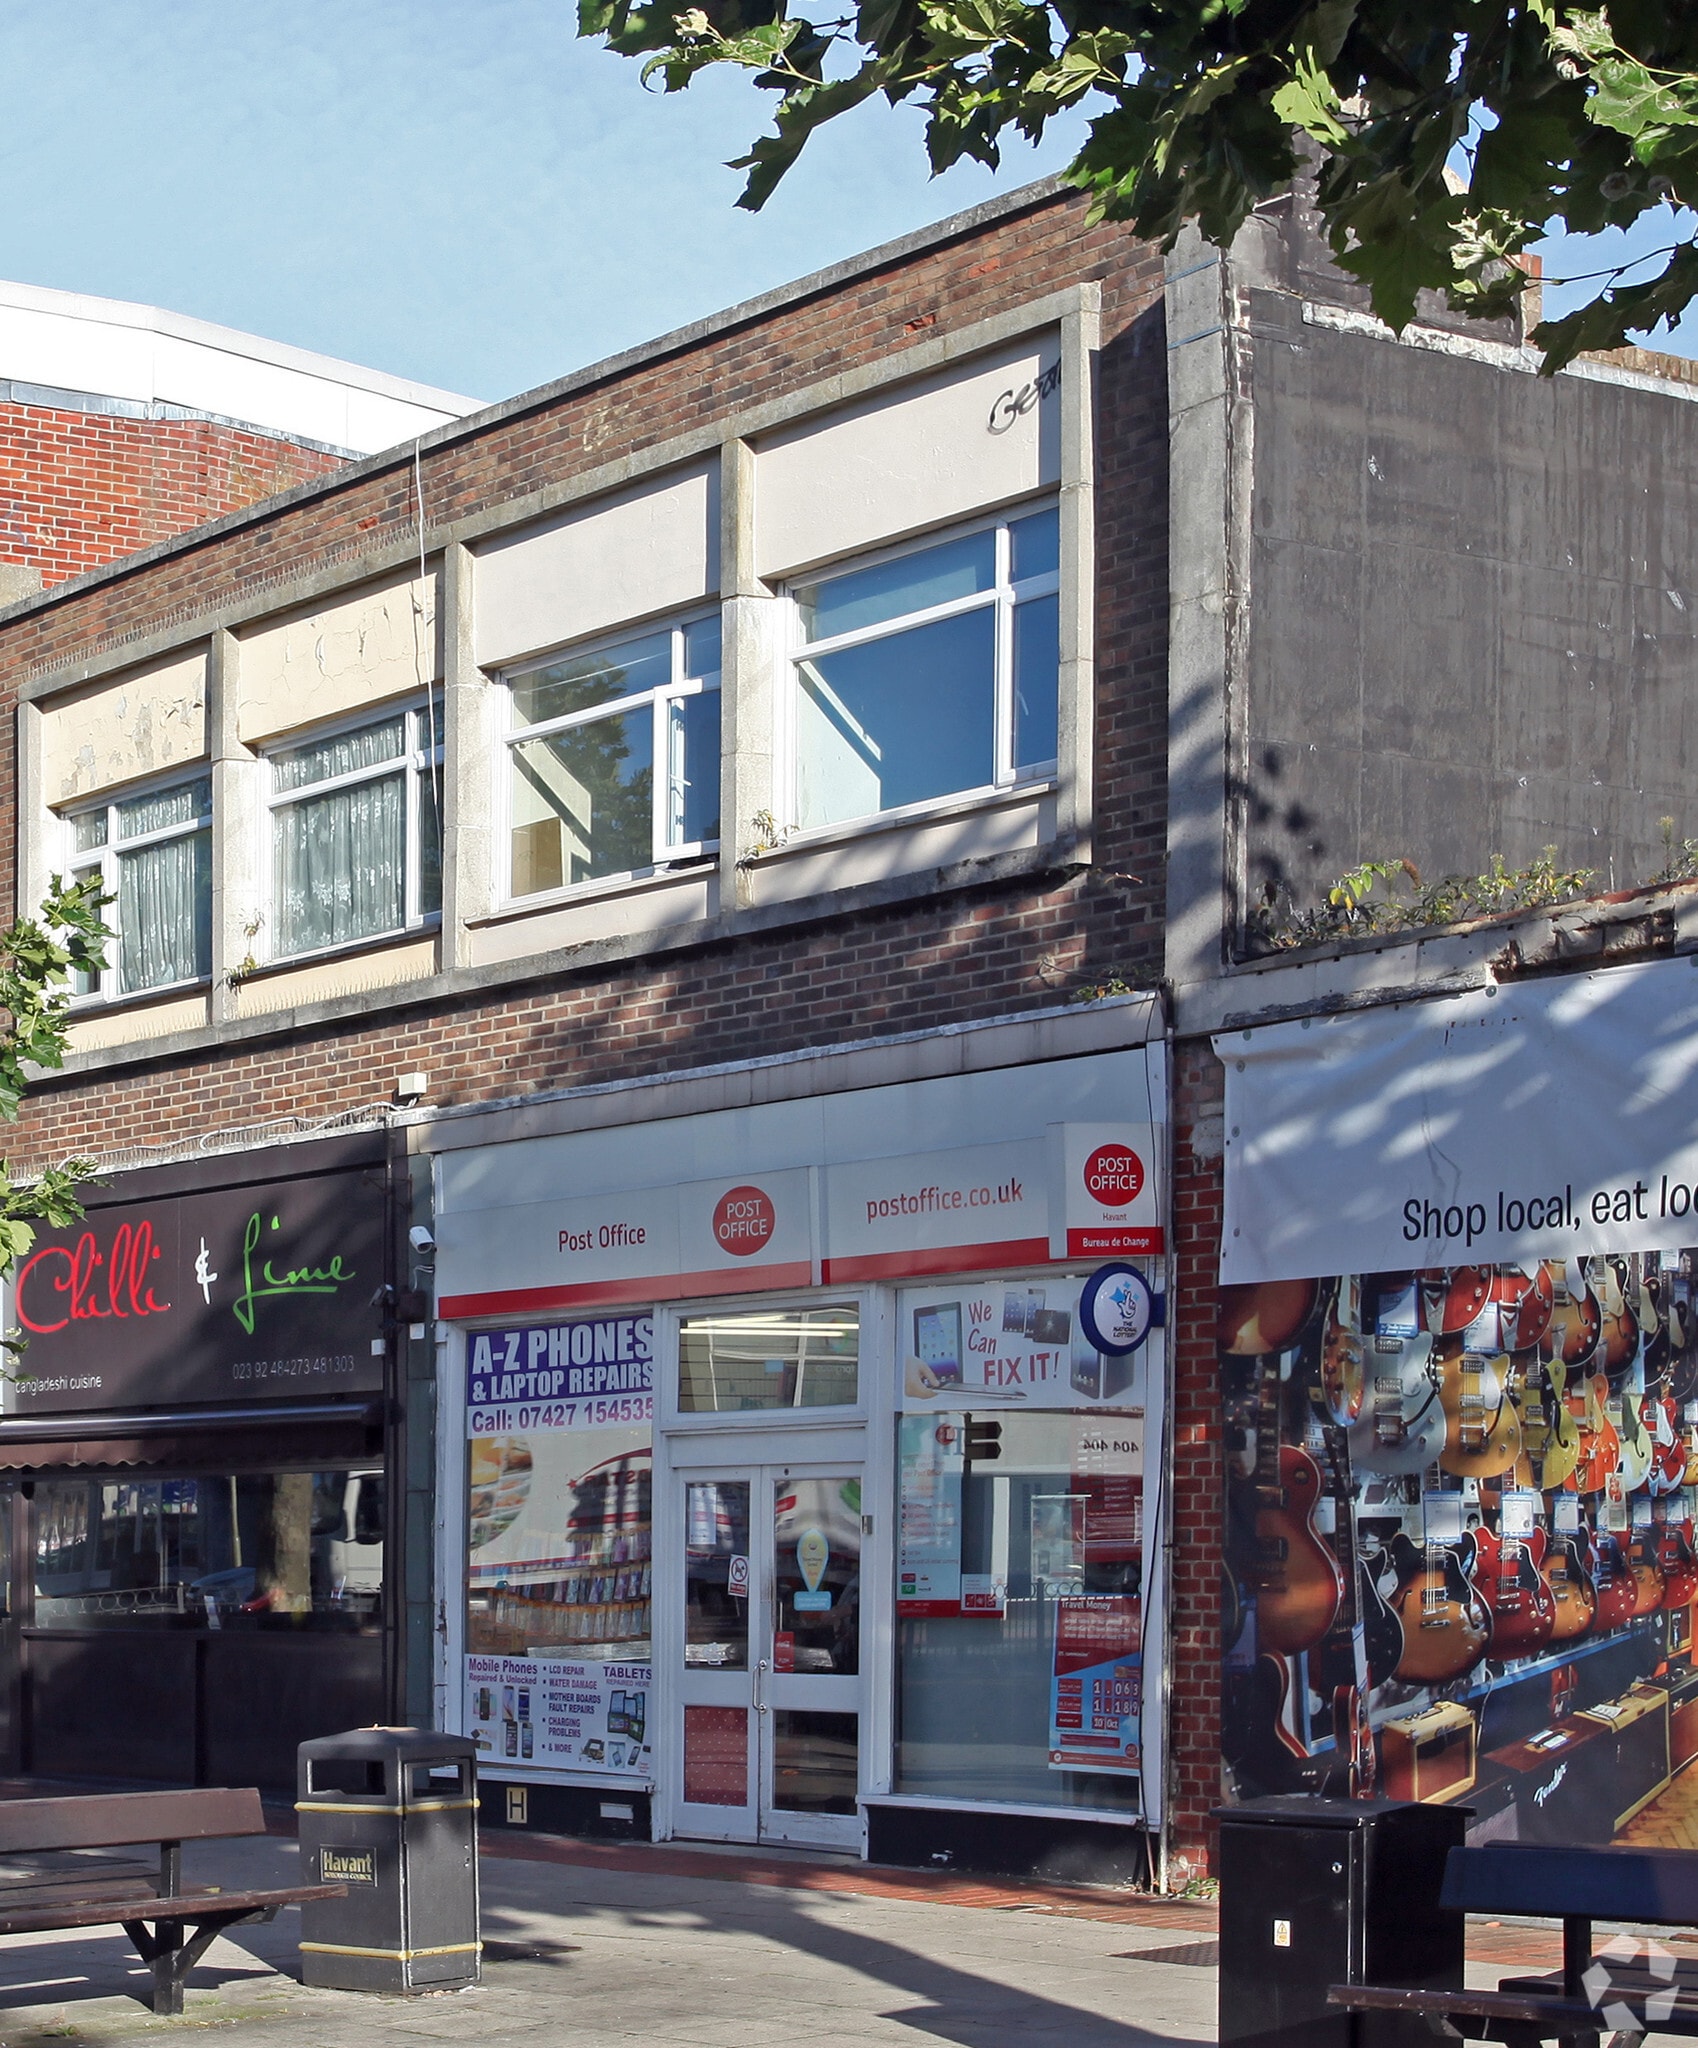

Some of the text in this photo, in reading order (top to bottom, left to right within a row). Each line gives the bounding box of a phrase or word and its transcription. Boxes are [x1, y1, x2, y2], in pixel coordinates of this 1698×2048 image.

[1097, 1158, 1132, 1173] POST
[1090, 1175, 1138, 1191] OFFICE
[726, 1199, 762, 1219] POST
[866, 1178, 1024, 1224] postoffice.co.uk
[1102, 1212, 1127, 1222] Havant
[1403, 1175, 1698, 1247] Shop local, eat lo
[559, 1224, 646, 1252] Post Office
[719, 1219, 768, 1240] OFFICE
[1082, 1236, 1150, 1249] Bureau de Change
[15, 1213, 356, 1334] Chilli & Lime
[968, 1300, 993, 1325] We
[472, 1318, 653, 1374] A-Z PHONES
[968, 1328, 997, 1355] Can
[233, 1363, 252, 1379] 023
[255, 1361, 268, 1378] 92
[984, 1351, 1060, 1385] FIX IT!
[69, 1373, 102, 1390] cuisine
[472, 1361, 653, 1402] & LAPTOP REPAIRS
[472, 1397, 653, 1433] Call: 07427 154535
[1061, 1600, 1112, 1612] Travel Money
[469, 1658, 538, 1675] Mobile Phones
[549, 1665, 585, 1676] LCD REPAIR
[603, 1666, 652, 1680] TABLETS
[469, 1672, 498, 1683] Repaired
[506, 1675, 537, 1685] Unlocked
[549, 1678, 598, 1690] WATER DAMAGE
[549, 1692, 601, 1704] MOTHER BOARDS
[548, 1703, 595, 1715] FAULT REPAIRS
[548, 1727, 581, 1738] PROBLEMS
[554, 1744, 572, 1754] MORE
[324, 1851, 373, 1873] Havant
